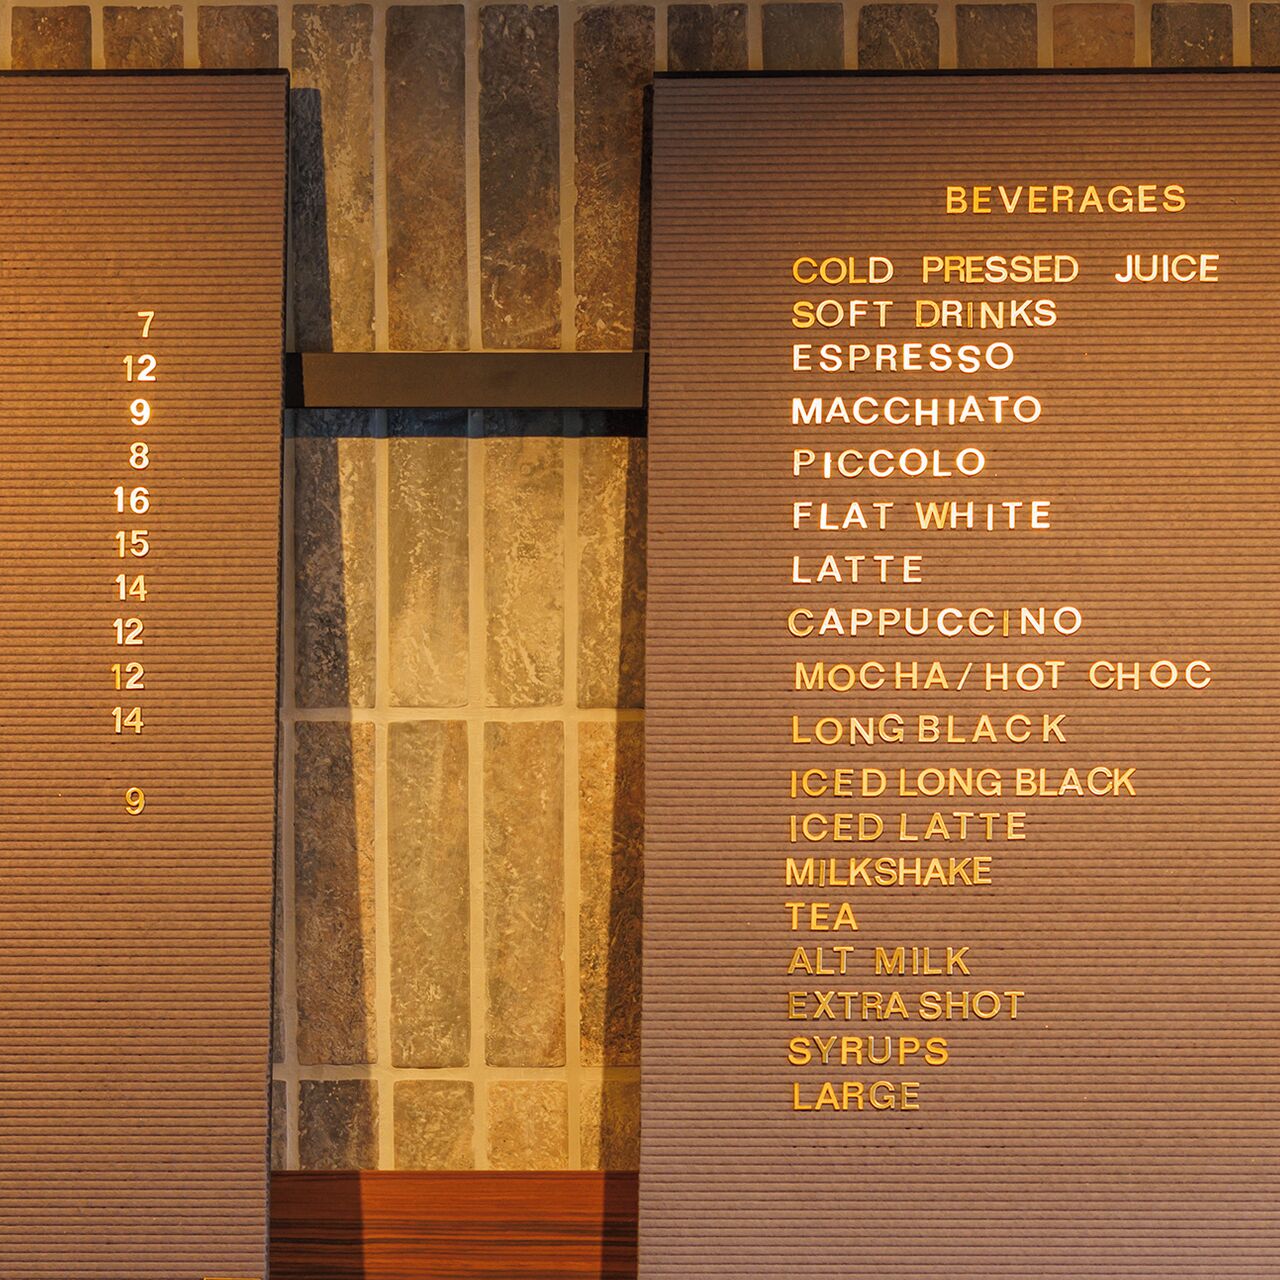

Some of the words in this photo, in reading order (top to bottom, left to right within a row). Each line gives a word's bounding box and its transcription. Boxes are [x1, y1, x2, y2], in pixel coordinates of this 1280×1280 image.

[946, 184, 1186, 214] BEVERAGES
[792, 256, 894, 284] COLD
[922, 254, 1079, 284] PRESSED
[1114, 253, 1220, 283] JUICE
[137, 310, 155, 338] 7
[791, 299, 894, 329] SOFT
[915, 299, 1057, 329] DRINKS
[122, 353, 157, 382] 12
[792, 341, 1014, 373] ESPRESSO
[129, 398, 152, 426] 9
[791, 394, 1042, 426] MACCHIATO
[129, 441, 150, 469] 8
[793, 447, 986, 479] PICCOLO
[113, 485, 150, 514] 16
[793, 501, 894, 530] FLAT
[915, 500, 1051, 531] WHITE
[115, 529, 149, 558] 15
[792, 554, 923, 583] LATTE
[115, 573, 148, 602] 14
[112, 617, 144, 645] 12
[788, 606, 1082, 637] CAPPUCCINO
[111, 661, 144, 690] 12
[1089, 660, 1211, 690] CHOC
[111, 706, 144, 734] 14
[792, 713, 904, 745] LONG
[918, 714, 1067, 743] BLACK
[791, 768, 887, 798] ICED
[899, 767, 1002, 796] LONG
[1015, 766, 1136, 796] BLACK
[125, 787, 145, 815] 9
[790, 812, 884, 842] ICED
[899, 811, 1026, 841] LATTE
[785, 856, 992, 887] MILKSHAKE
[785, 902, 859, 930] TEA
[787, 946, 855, 975] ALT
[875, 946, 971, 975] MILK
[789, 990, 910, 1020] EXTRA
[919, 990, 1025, 1020] SHOT
[788, 1035, 948, 1065] SYRUPS
[794, 1080, 920, 1110] LARGE
